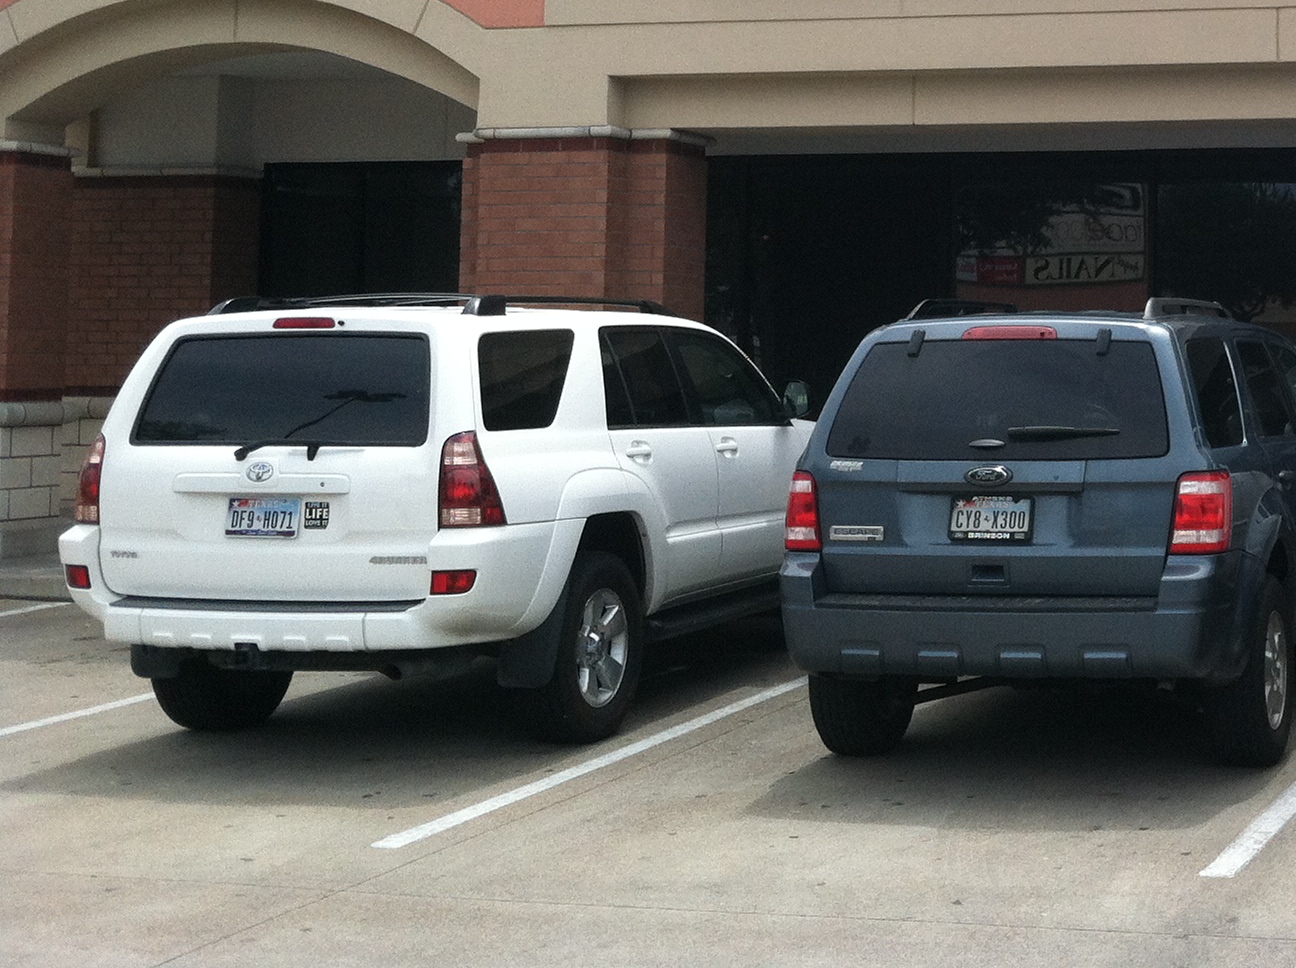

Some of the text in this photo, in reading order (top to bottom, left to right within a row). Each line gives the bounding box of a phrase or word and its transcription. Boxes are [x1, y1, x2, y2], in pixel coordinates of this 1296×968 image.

[305, 508, 329, 519] LIFE
[956, 510, 1026, 529] CY8 X300
